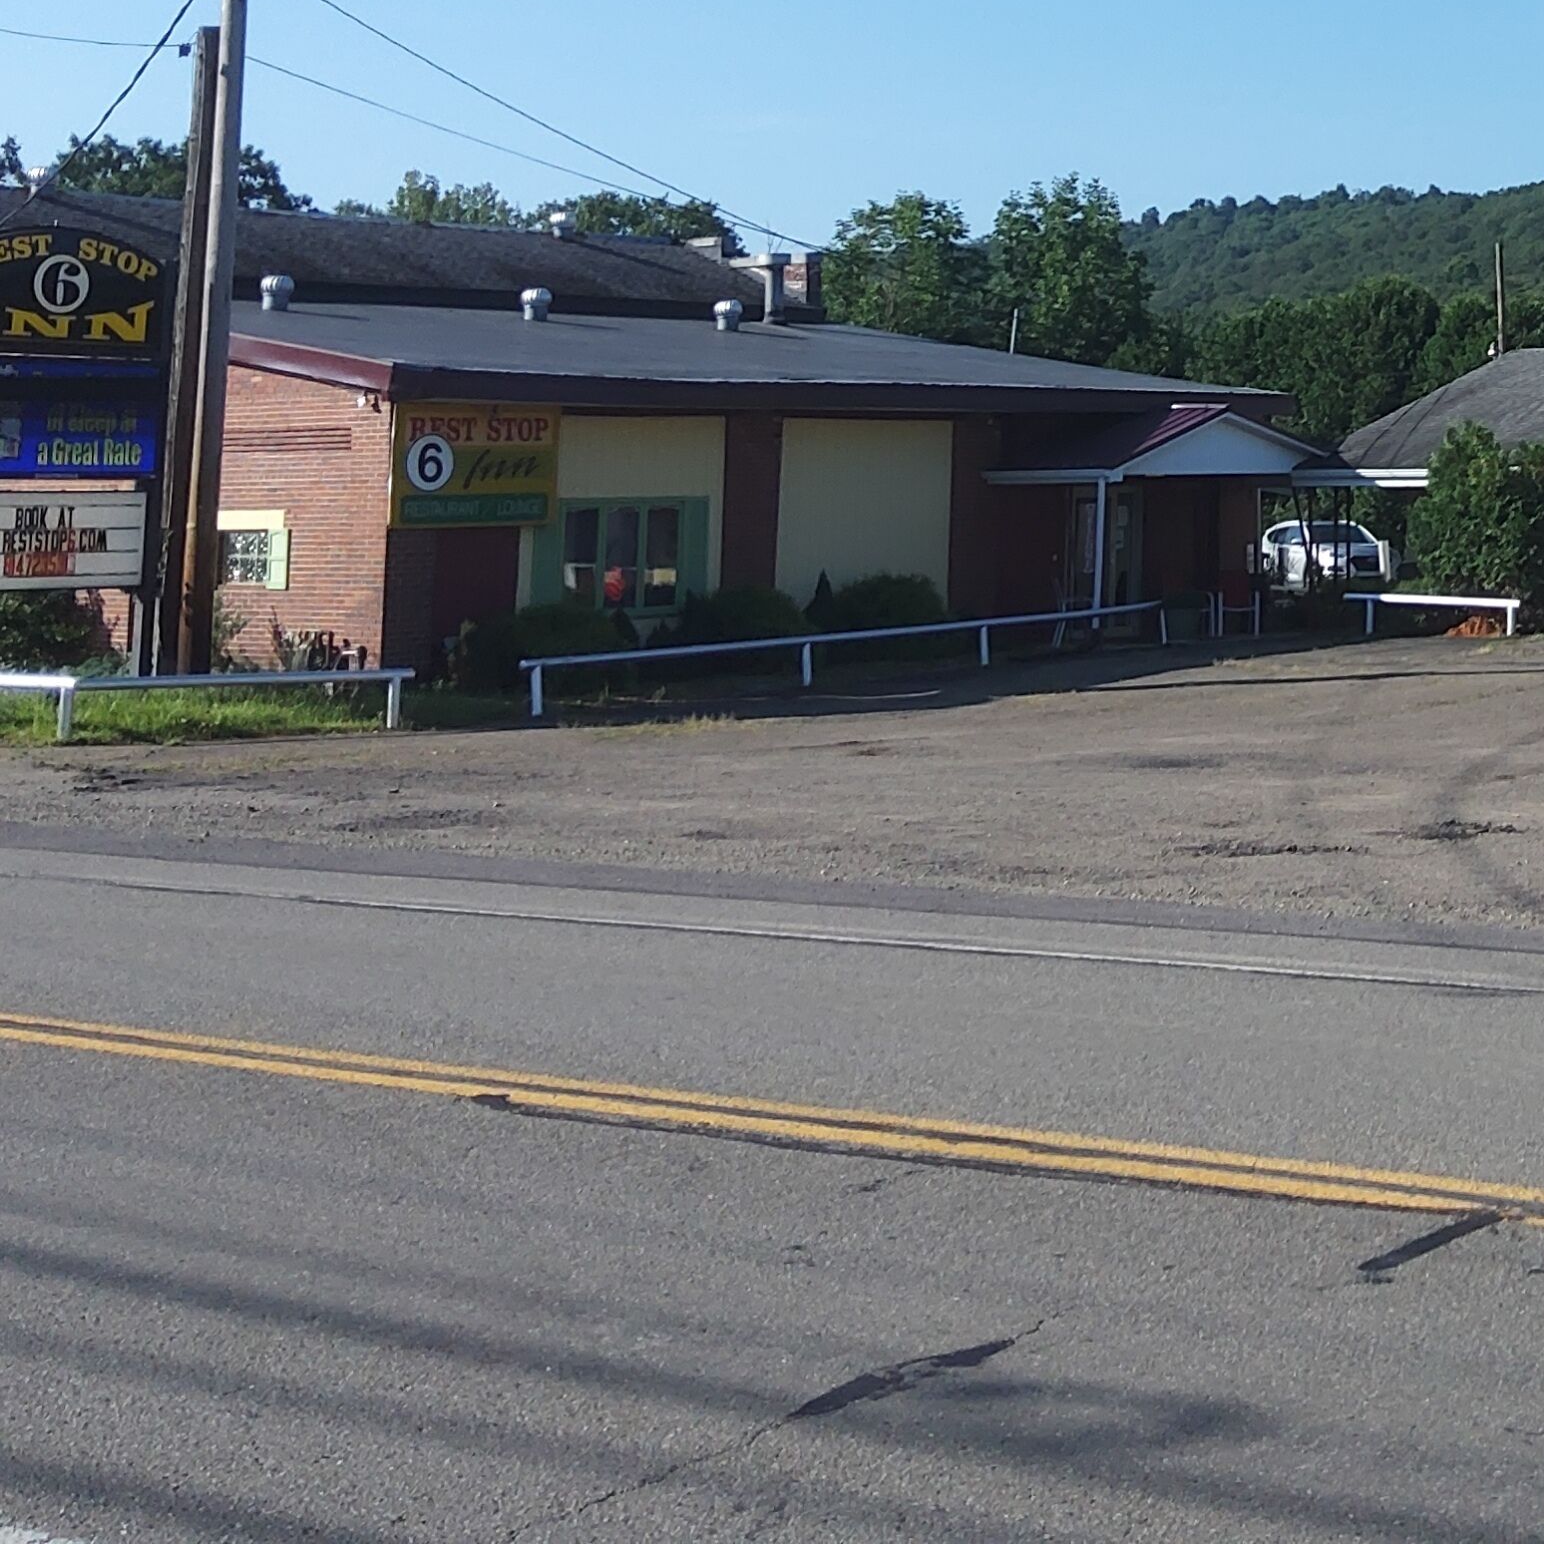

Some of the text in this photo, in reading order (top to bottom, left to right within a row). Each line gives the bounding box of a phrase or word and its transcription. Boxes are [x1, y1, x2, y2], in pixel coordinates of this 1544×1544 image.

[0, 234, 158, 282] EST STOP
[2, 300, 155, 342] NN
[409, 417, 549, 442] REST STOP
[37, 438, 142, 466] a Great Rate
[418, 443, 443, 482] 6
[463, 449, 541, 489] Inn
[15, 506, 75, 529] BOOK AT
